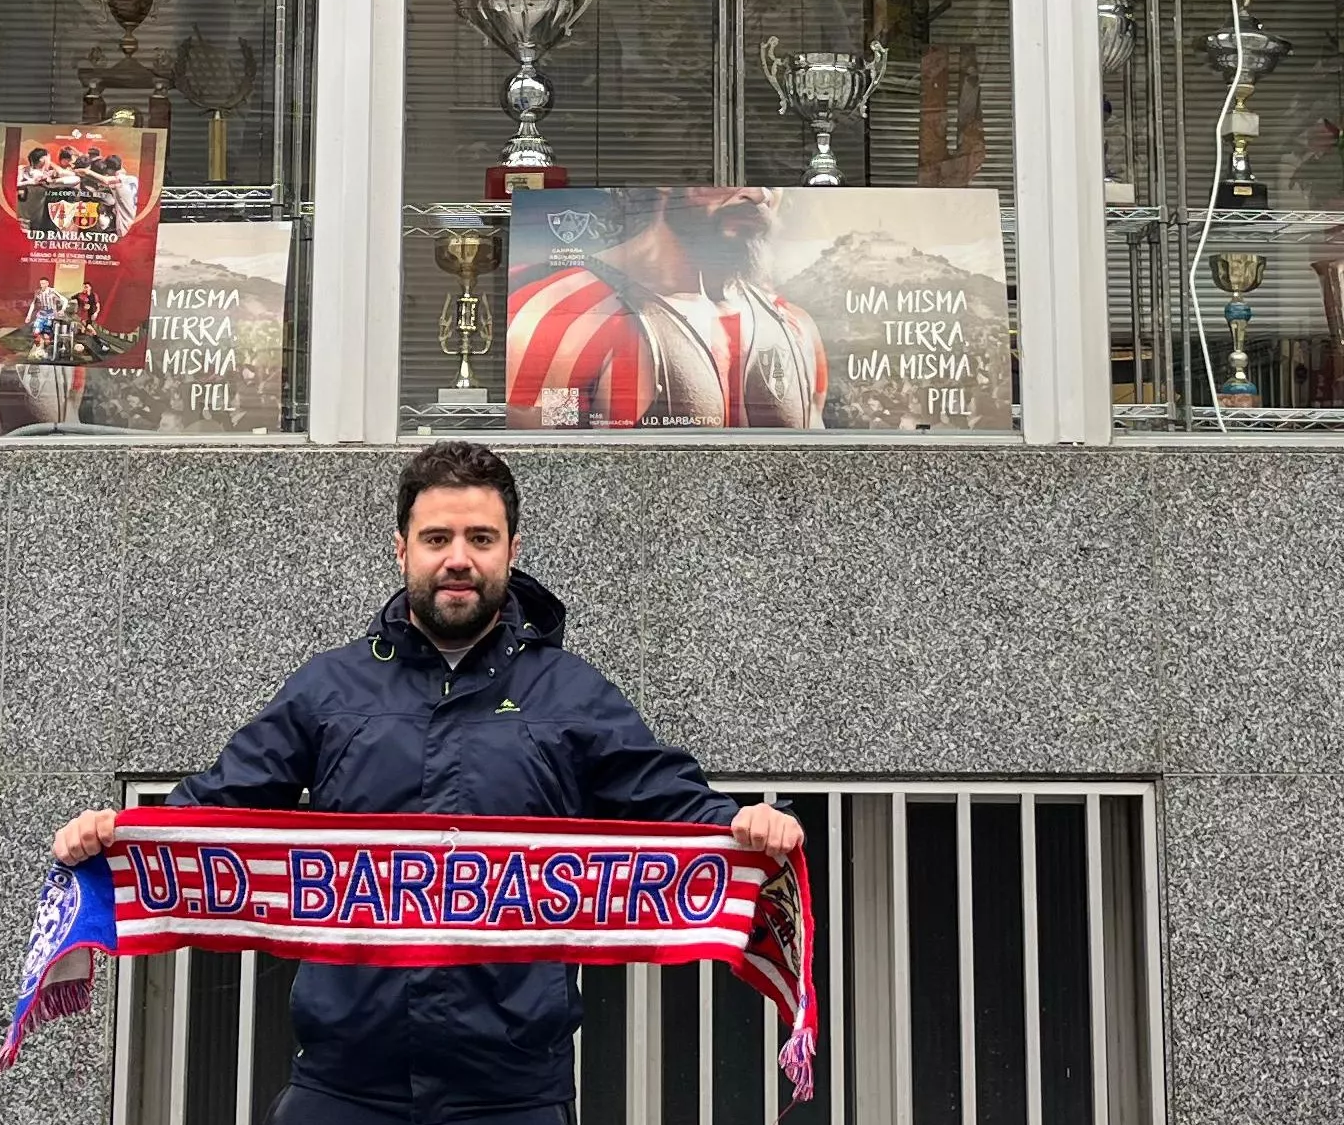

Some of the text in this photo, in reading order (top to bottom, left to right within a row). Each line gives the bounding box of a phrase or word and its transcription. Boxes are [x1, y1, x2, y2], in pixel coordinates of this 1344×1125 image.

[27, 229, 118, 244] UD BARBASTRO
[34, 240, 108, 252] FC BARCELONA
[166, 288, 240, 311] MISMA
[845, 285, 968, 315] UNA MISMA
[162, 348, 237, 376] MISMA
[847, 349, 973, 382] UNA MISMA
[190, 382, 236, 412] PIEL
[927, 387, 972, 415] PIEL
[641, 415, 722, 426] U.D. BARBASTRO
[124, 842, 732, 928] U.D. BARBASTRO
